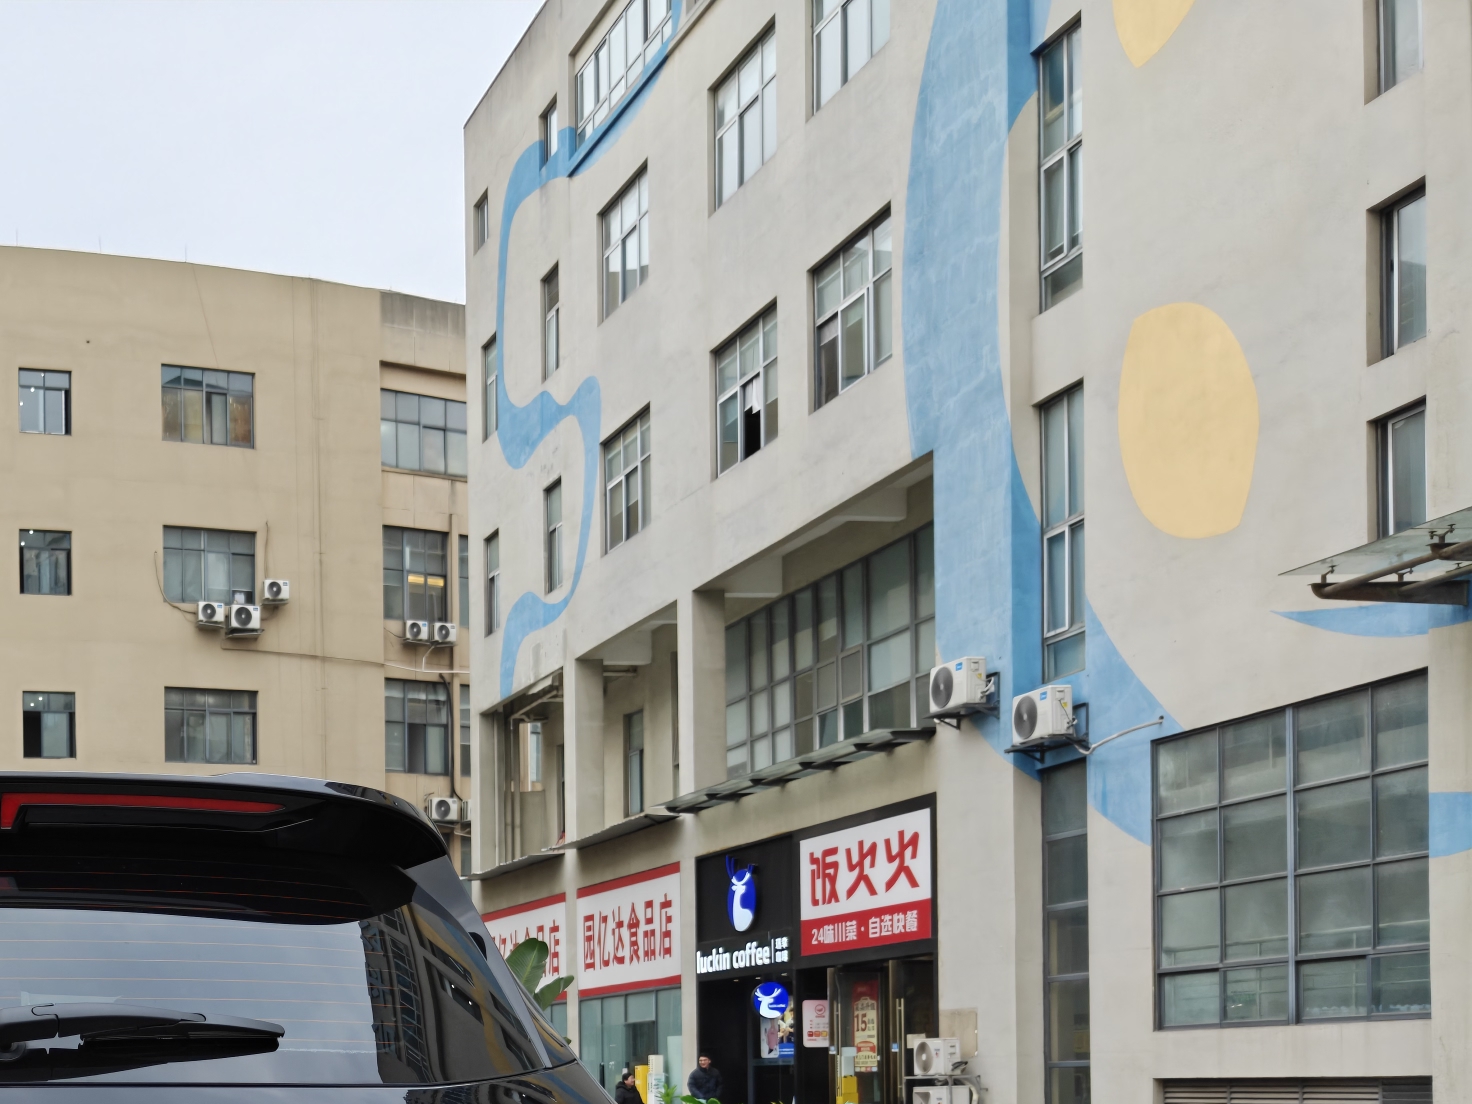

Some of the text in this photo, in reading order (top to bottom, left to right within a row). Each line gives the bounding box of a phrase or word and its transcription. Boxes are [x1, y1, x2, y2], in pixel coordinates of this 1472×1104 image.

[809, 829, 920, 907] 饭火火
[583, 893, 673, 972] 园亿达食品店
[696, 941, 770, 974] luckin coffee
